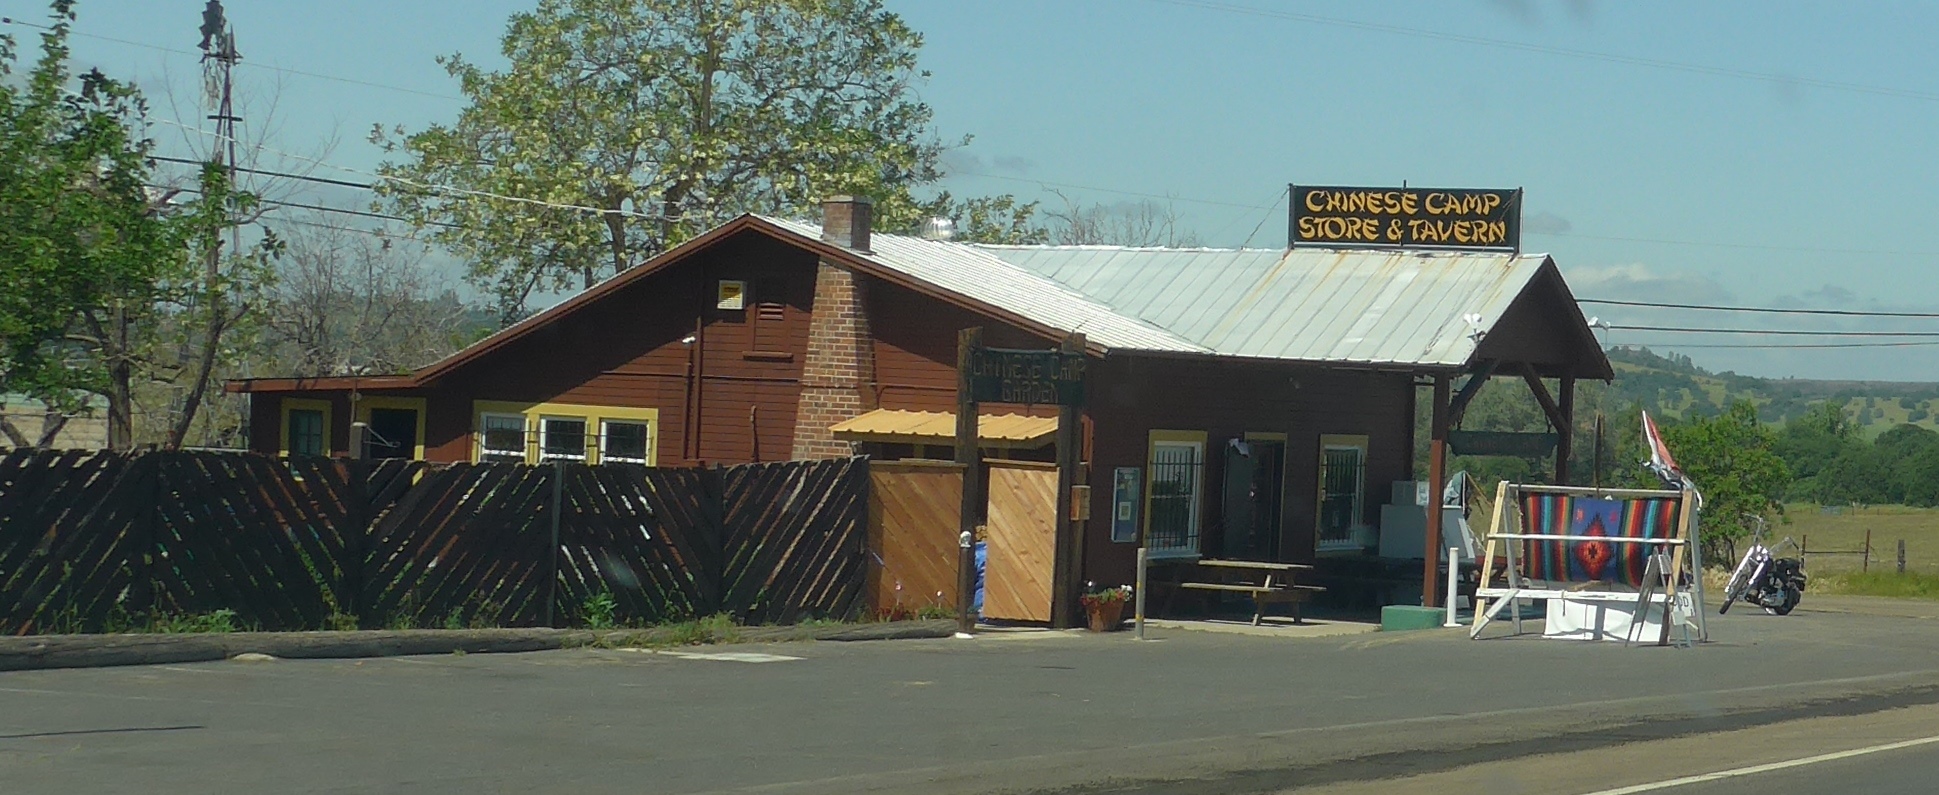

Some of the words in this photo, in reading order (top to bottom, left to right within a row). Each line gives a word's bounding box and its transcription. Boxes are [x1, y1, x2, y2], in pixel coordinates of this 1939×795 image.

[1305, 190, 1418, 215] CHINESE
[1425, 192, 1500, 216] CAMP
[1299, 216, 1379, 240] STORE
[1387, 218, 1404, 240] &
[1408, 219, 1506, 243] TAVERN
[973, 352, 1041, 379] CHINESE
[1050, 355, 1087, 381] CAMP
[1002, 379, 1059, 404] GARDEN
